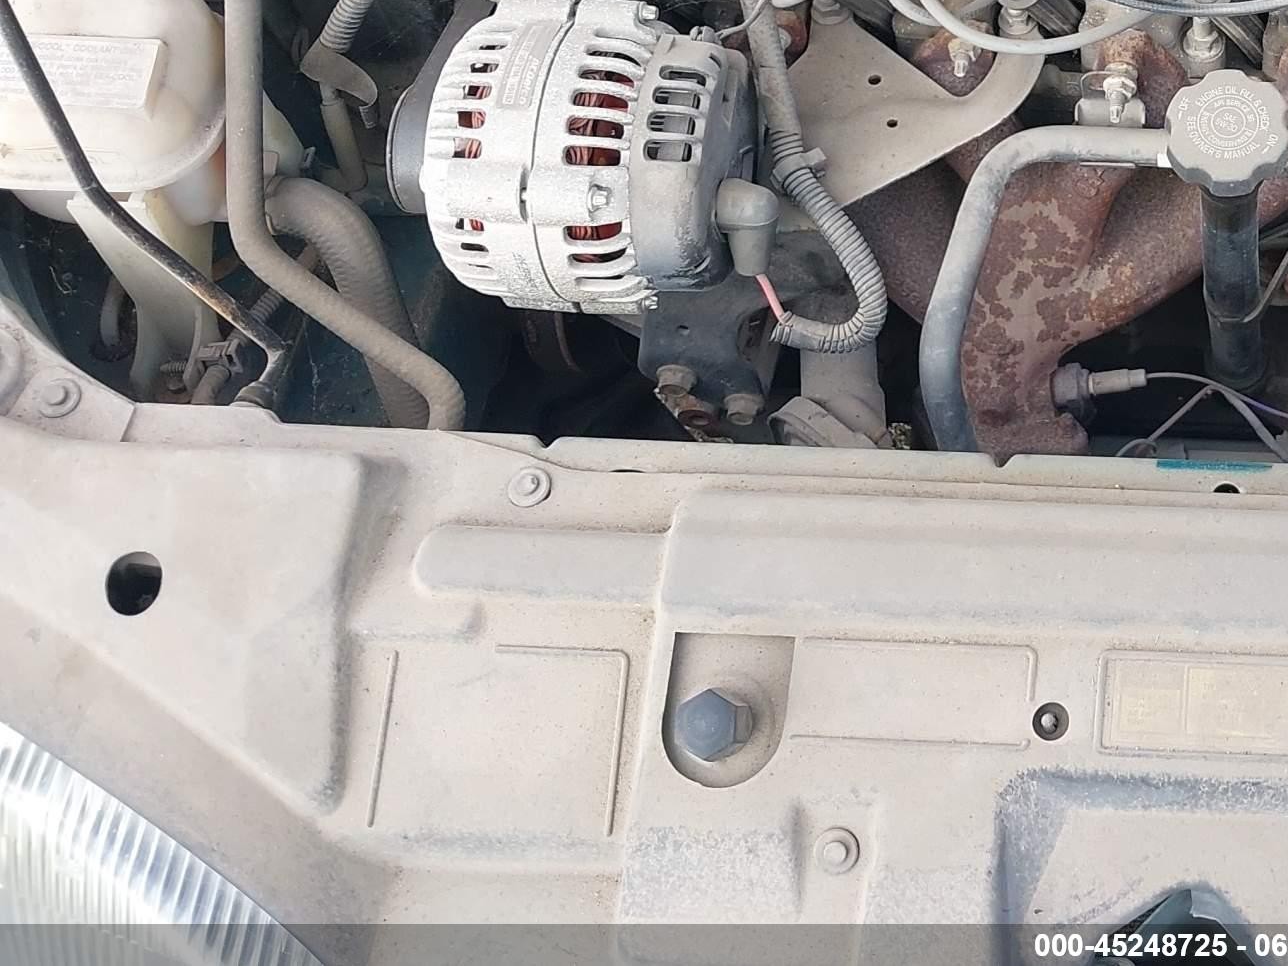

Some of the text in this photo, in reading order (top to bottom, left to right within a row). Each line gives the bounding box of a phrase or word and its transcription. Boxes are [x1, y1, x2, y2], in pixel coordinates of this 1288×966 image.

[73, 44, 117, 54] COOLANT
[1195, 86, 1224, 107] ENGINE
[1224, 85, 1238, 95] OIL
[1239, 88, 1255, 101] FILL
[1257, 105, 1270, 131] CHECK
[1186, 115, 1197, 131] SEE
[1223, 141, 1261, 159] MANUAL
[1266, 133, 1279, 147] ON
